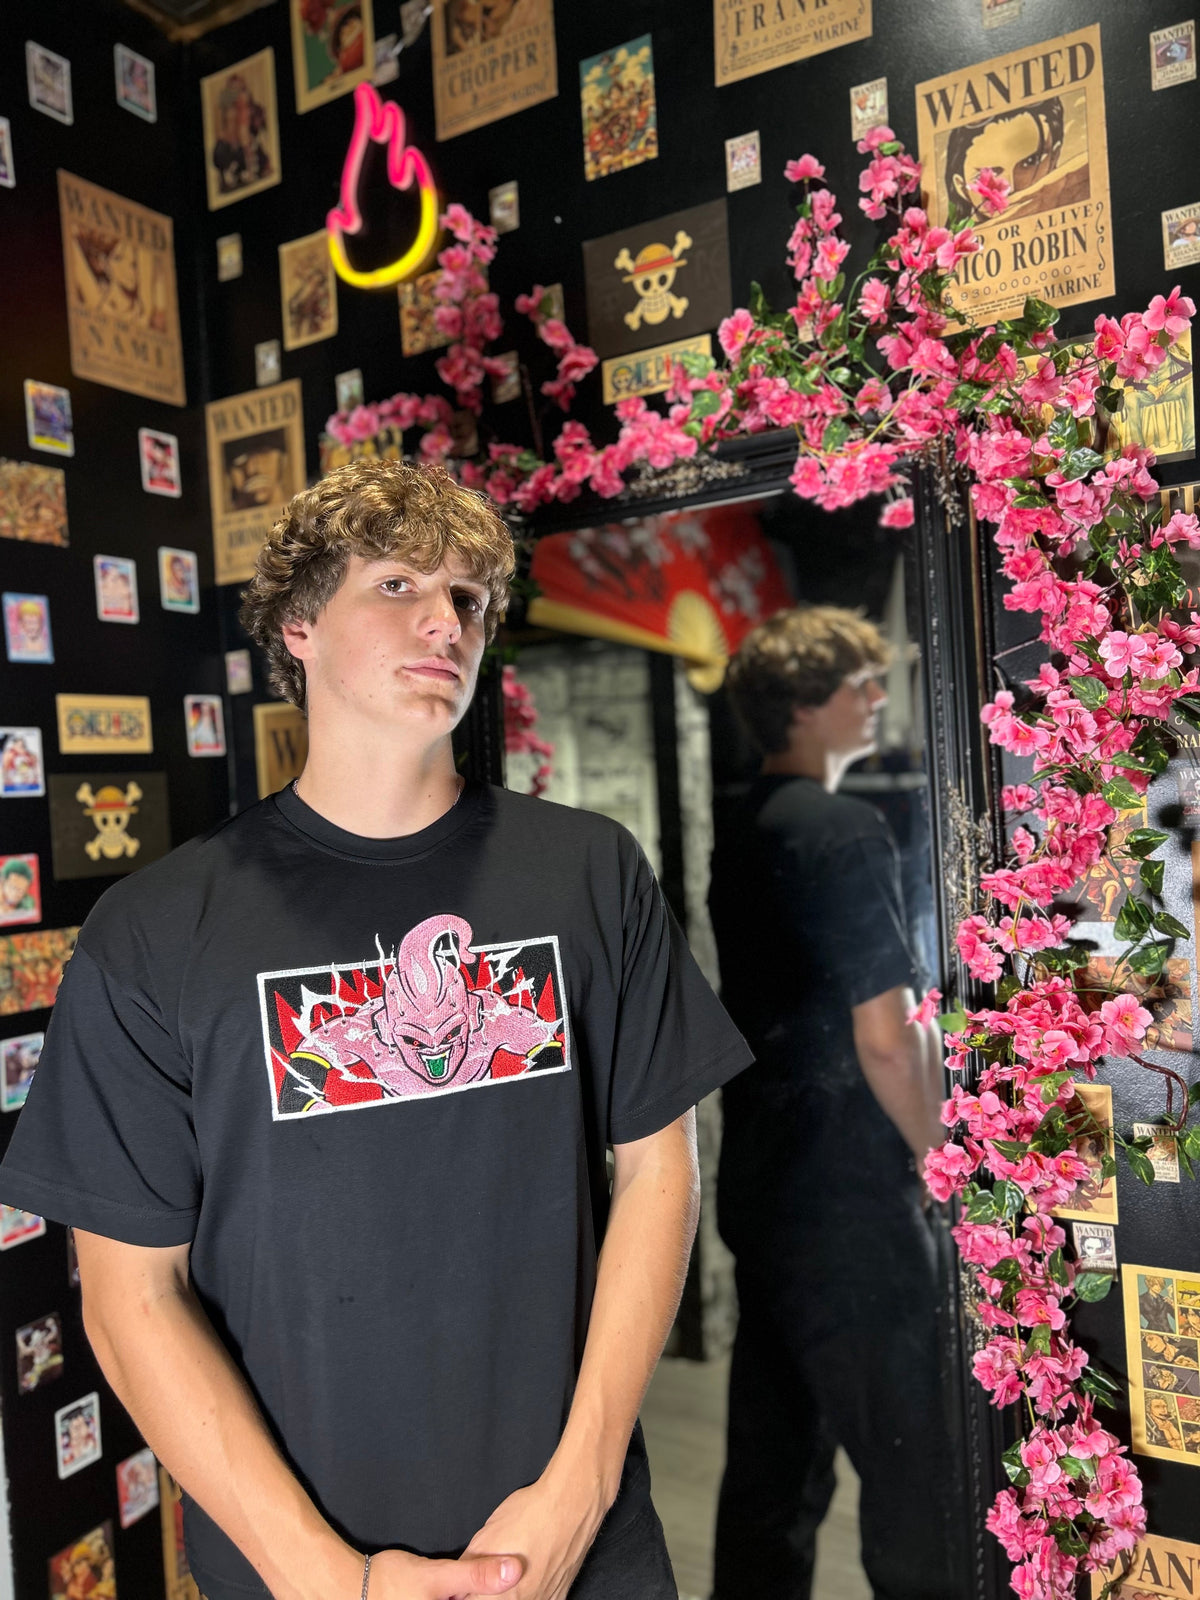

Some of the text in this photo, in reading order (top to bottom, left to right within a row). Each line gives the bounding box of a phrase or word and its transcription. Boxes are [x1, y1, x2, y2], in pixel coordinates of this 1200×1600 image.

[813, 17, 860, 43] MARINE
[1153, 23, 1194, 43] WANTED
[448, 41, 538, 99] CHOPPER
[922, 41, 1096, 129] WANTED
[65, 184, 168, 253] WANTED
[998, 225, 1021, 242] OR
[1034, 203, 1093, 232] ALIVE
[1165, 204, 1200, 222] WANTE
[1012, 224, 1088, 273] ROBIN
[1043, 272, 1102, 301] MARINE
[89, 324, 163, 368] NAMI
[212, 392, 297, 434] WANTED
[1075, 1225, 1113, 1238] WANTED
[1108, 1544, 1200, 1596] WAN
